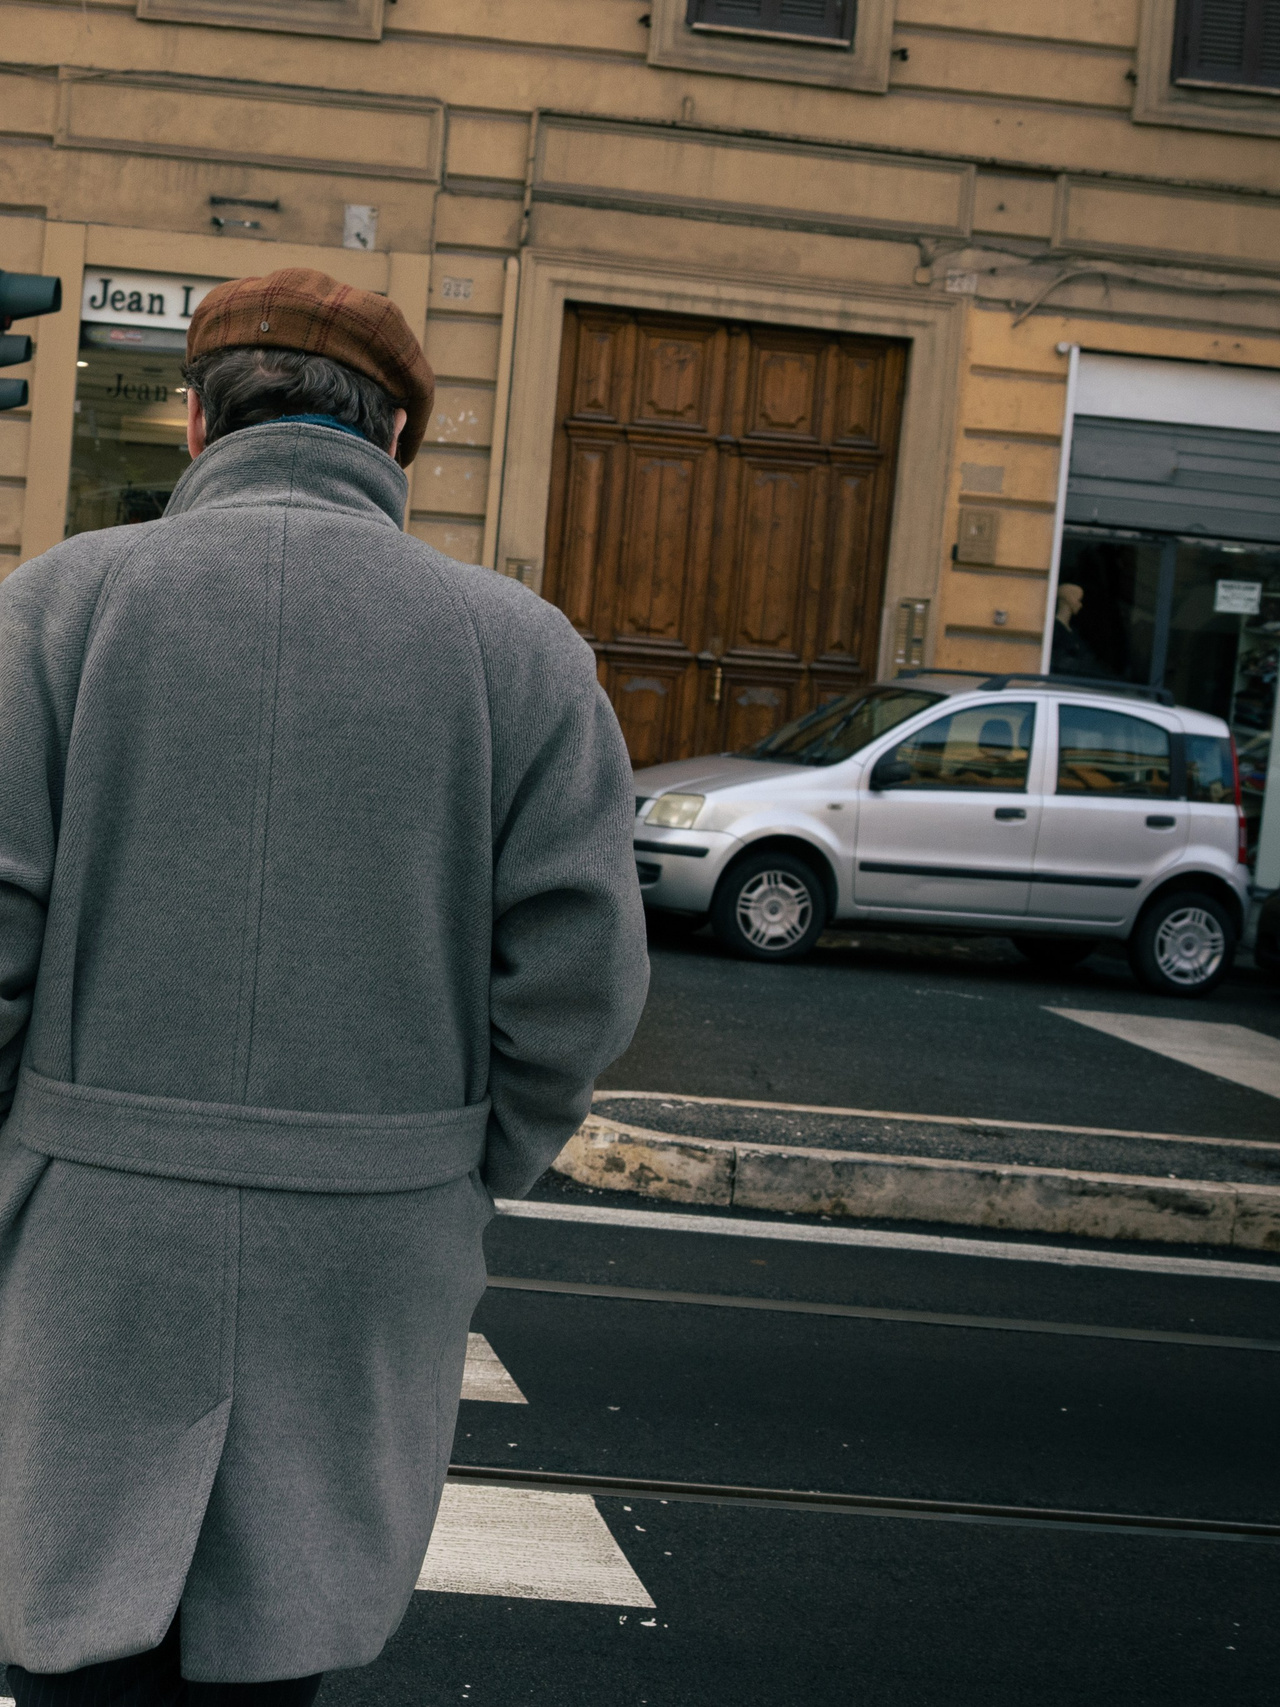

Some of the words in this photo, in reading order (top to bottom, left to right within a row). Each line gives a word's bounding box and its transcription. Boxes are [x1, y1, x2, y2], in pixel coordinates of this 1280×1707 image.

[89, 278, 165, 316] Jean
[179, 285, 195, 319] L
[105, 373, 168, 403] Jean
